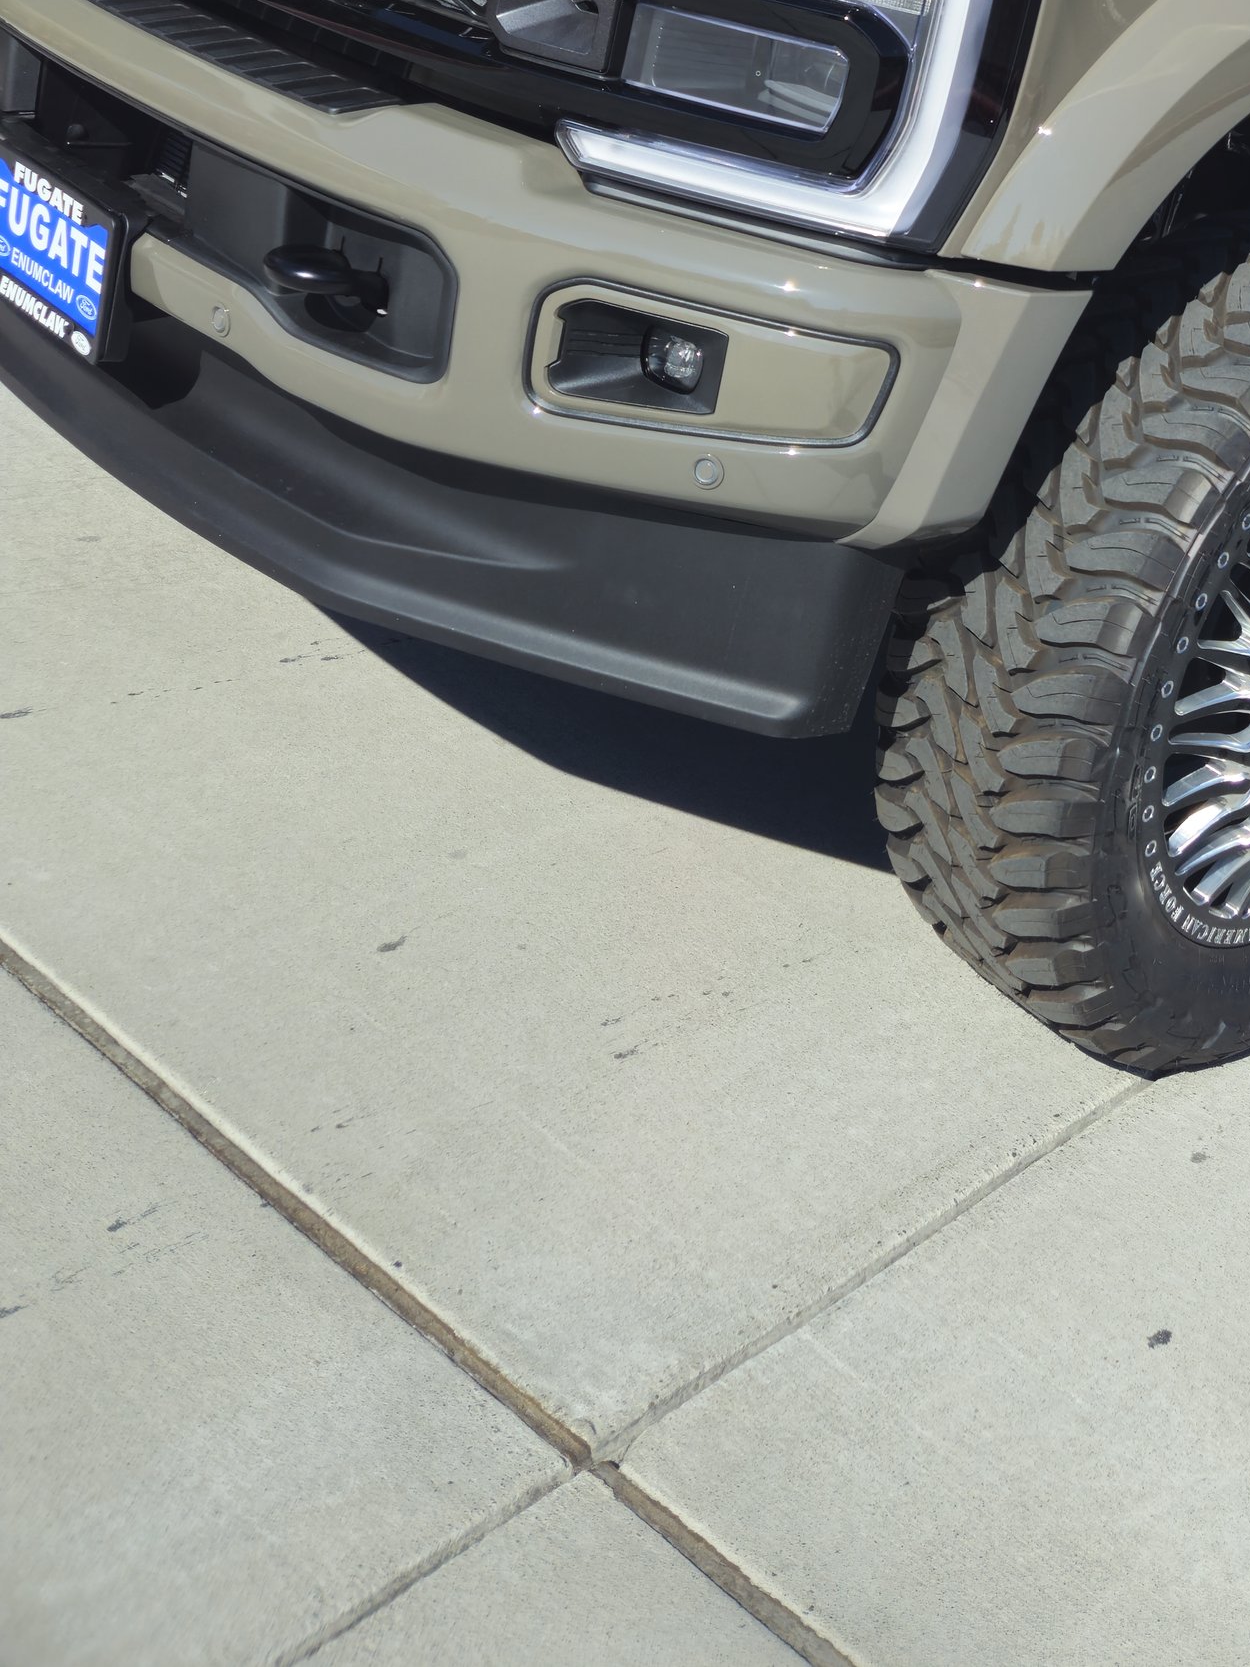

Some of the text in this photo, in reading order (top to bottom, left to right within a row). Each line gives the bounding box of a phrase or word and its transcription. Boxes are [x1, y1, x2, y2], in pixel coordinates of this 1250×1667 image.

[14, 161, 84, 225] FUGATE
[11, 246, 75, 304] ENUMCLAW
[0, 275, 70, 338] ENUMCLAW
[1149, 861, 1184, 922] FORCE
